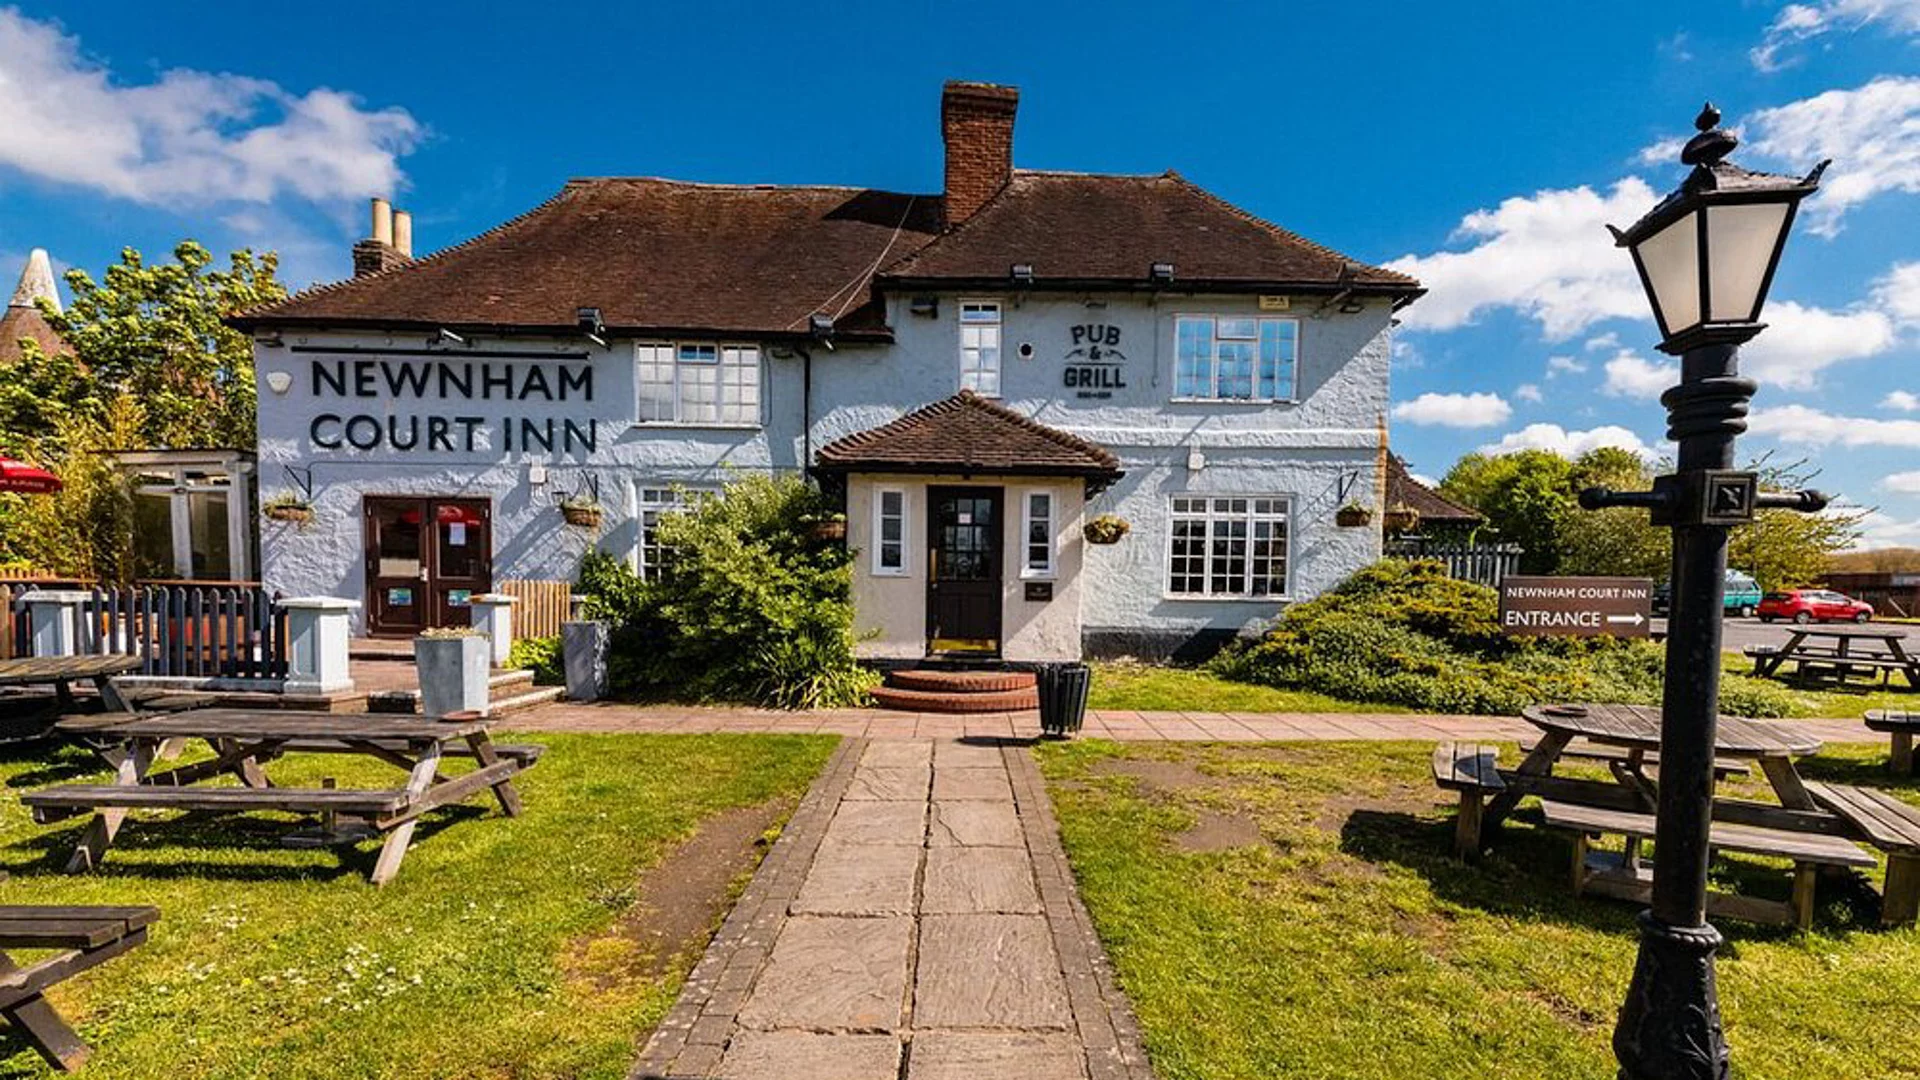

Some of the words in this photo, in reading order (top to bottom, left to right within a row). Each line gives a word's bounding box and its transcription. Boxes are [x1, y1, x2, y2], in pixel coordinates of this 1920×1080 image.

[1071, 324, 1121, 345] PUB
[1089, 346, 1101, 360] &
[312, 360, 593, 401] NEWNHAM
[1064, 367, 1126, 388] GRILL
[310, 414, 485, 452] COURT
[503, 416, 597, 453] INN
[1507, 587, 1575, 598] NEWNHAM
[1578, 588, 1620, 599] COURT
[1621, 589, 1647, 599] INN
[1505, 610, 1601, 627] ENTRANCE
